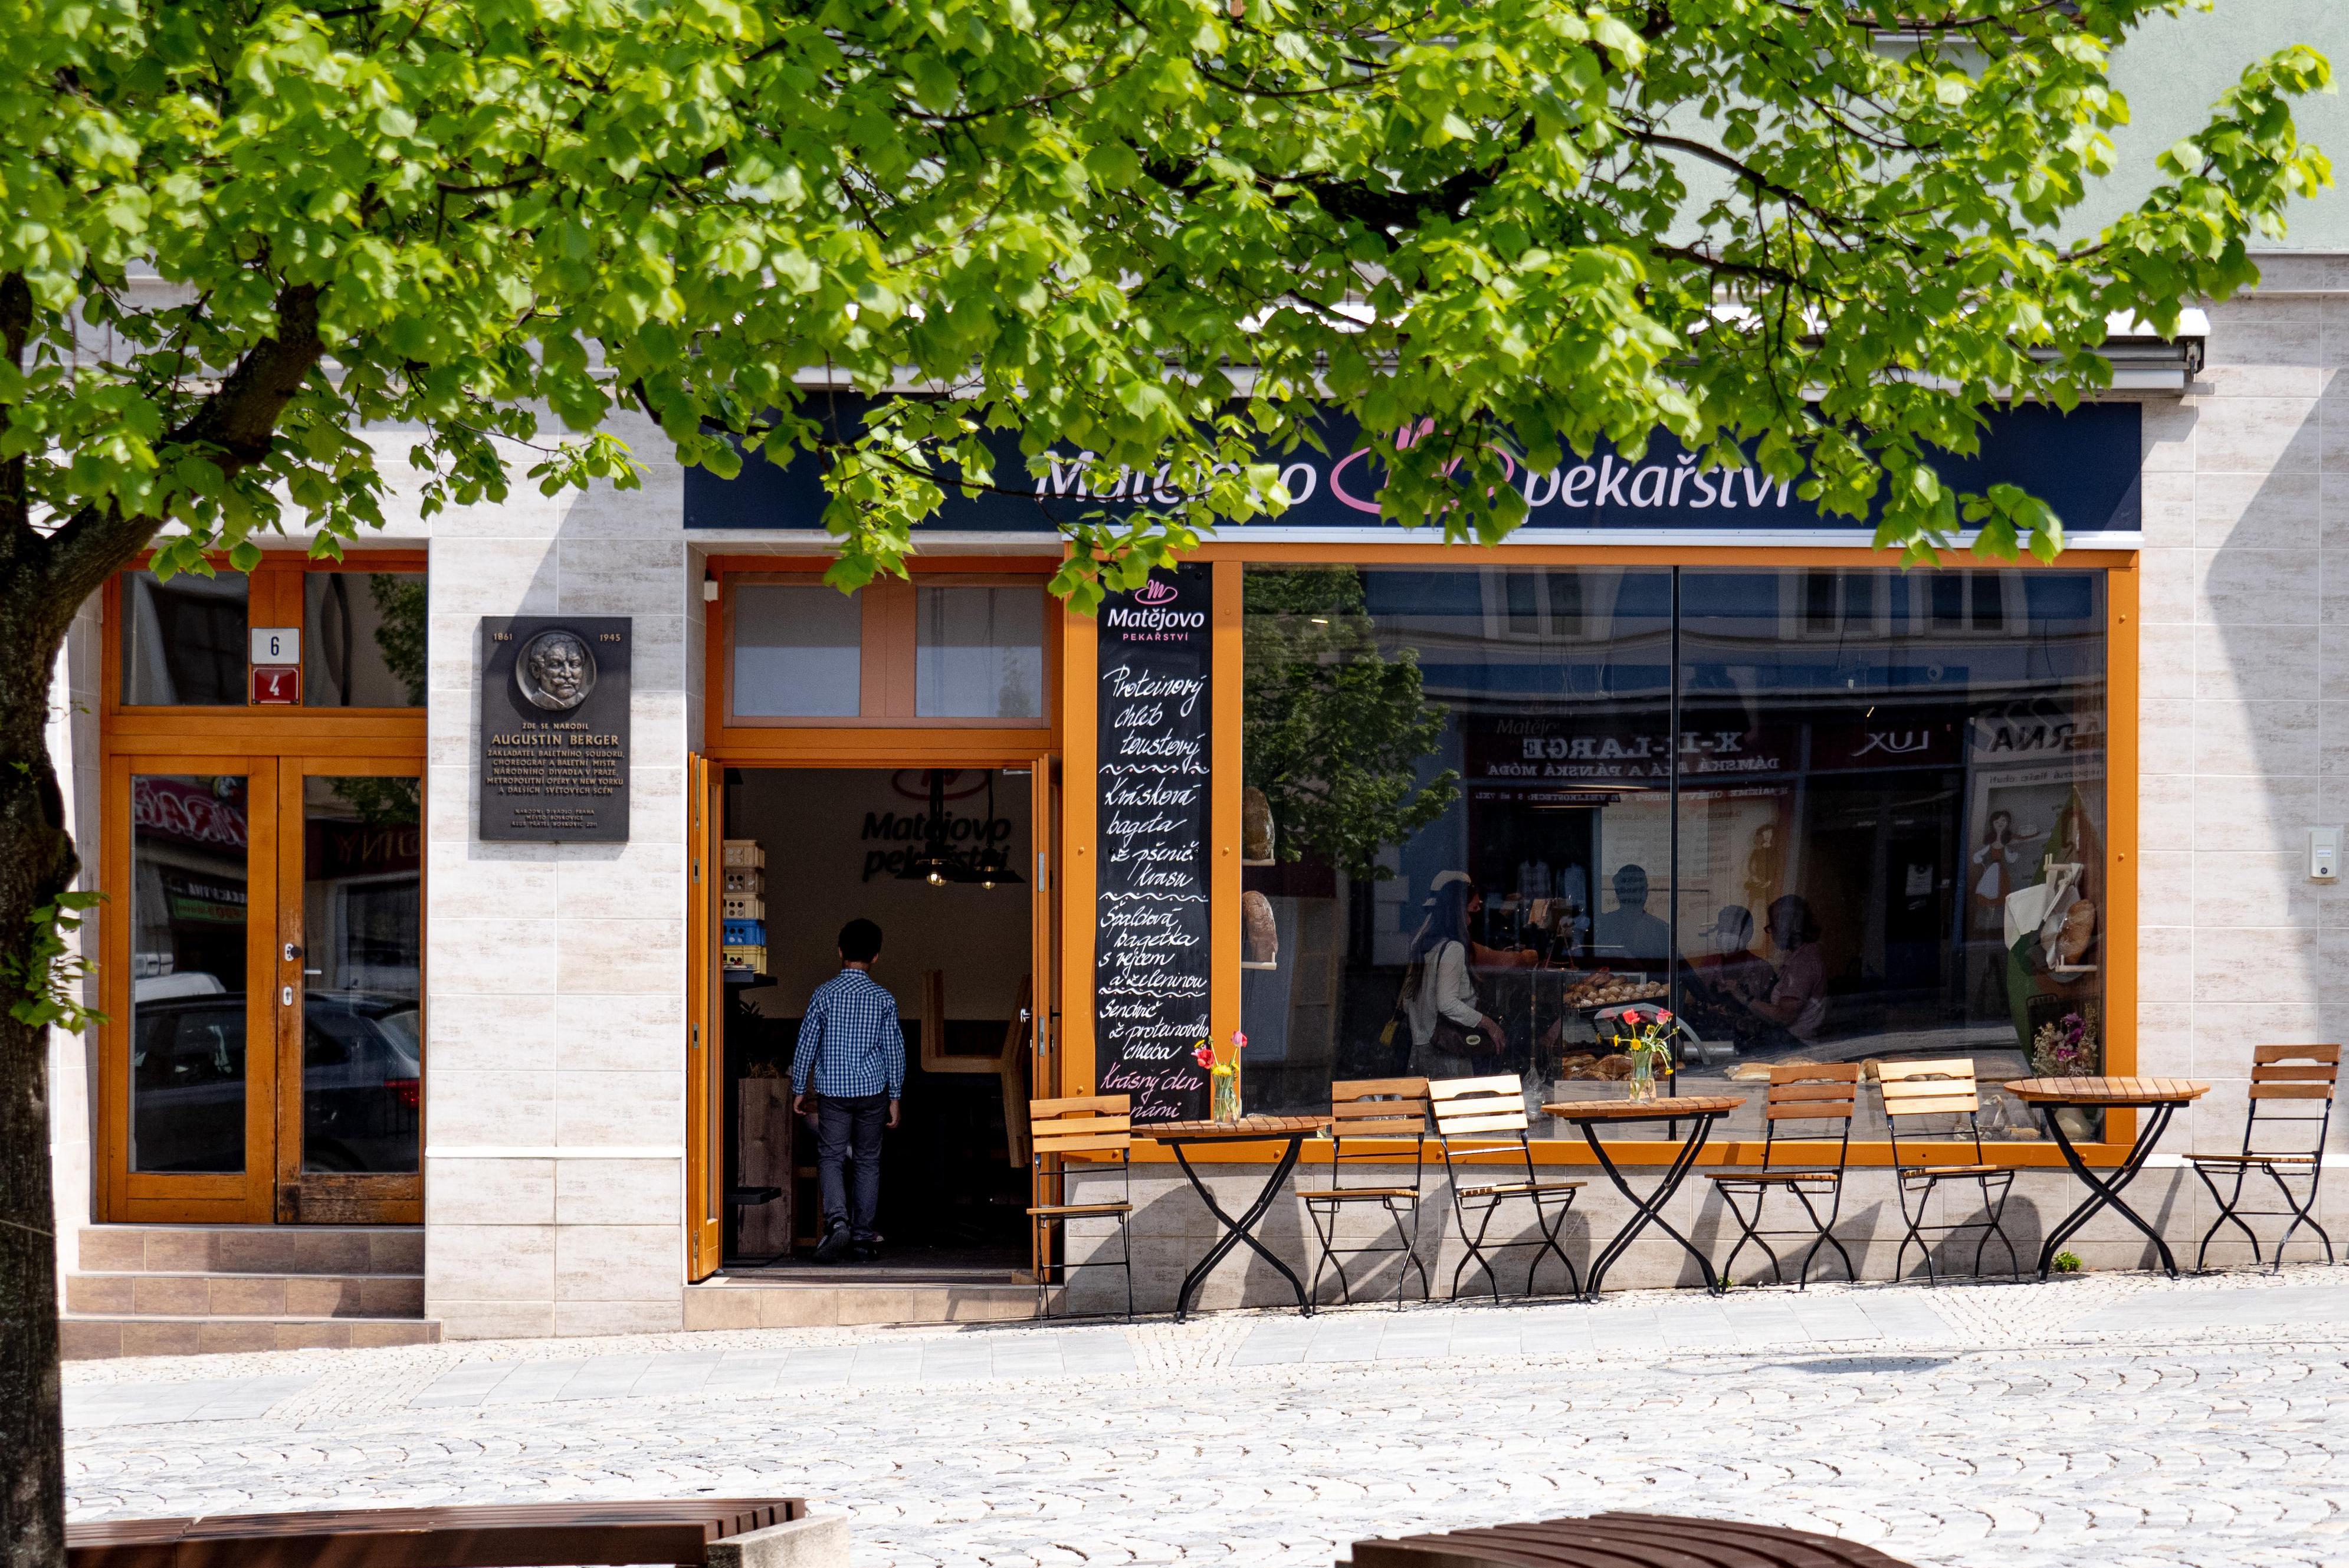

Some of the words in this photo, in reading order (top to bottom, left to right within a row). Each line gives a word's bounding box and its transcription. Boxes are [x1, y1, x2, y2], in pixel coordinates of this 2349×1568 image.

[1107, 608, 1205, 631] Matějovo
[271, 636, 280, 656] 6
[493, 632, 513, 641] 1861
[599, 634, 621, 642] 1945
[1123, 632, 1189, 641] PEKAŘSTVÍ
[269, 674, 280, 696] 4
[1103, 664, 1207, 717] Proteinový
[492, 734, 562, 745] AUGUSTIN
[570, 734, 619, 746] BERGER
[1120, 727, 1206, 774] toustový
[1106, 810, 1187, 848] bageta
[1101, 900, 1183, 938] Špaldová
[1114, 925, 1199, 958] bagetka
[1098, 952, 1113, 967] s
[1110, 976, 1124, 986] a
[1100, 998, 1164, 1019] Sendvič
[1123, 1041, 1182, 1061] chleba
[1100, 1061, 1170, 1106] Krásný
[1161, 1068, 1204, 1091] den
[1130, 1100, 1182, 1118] námi
